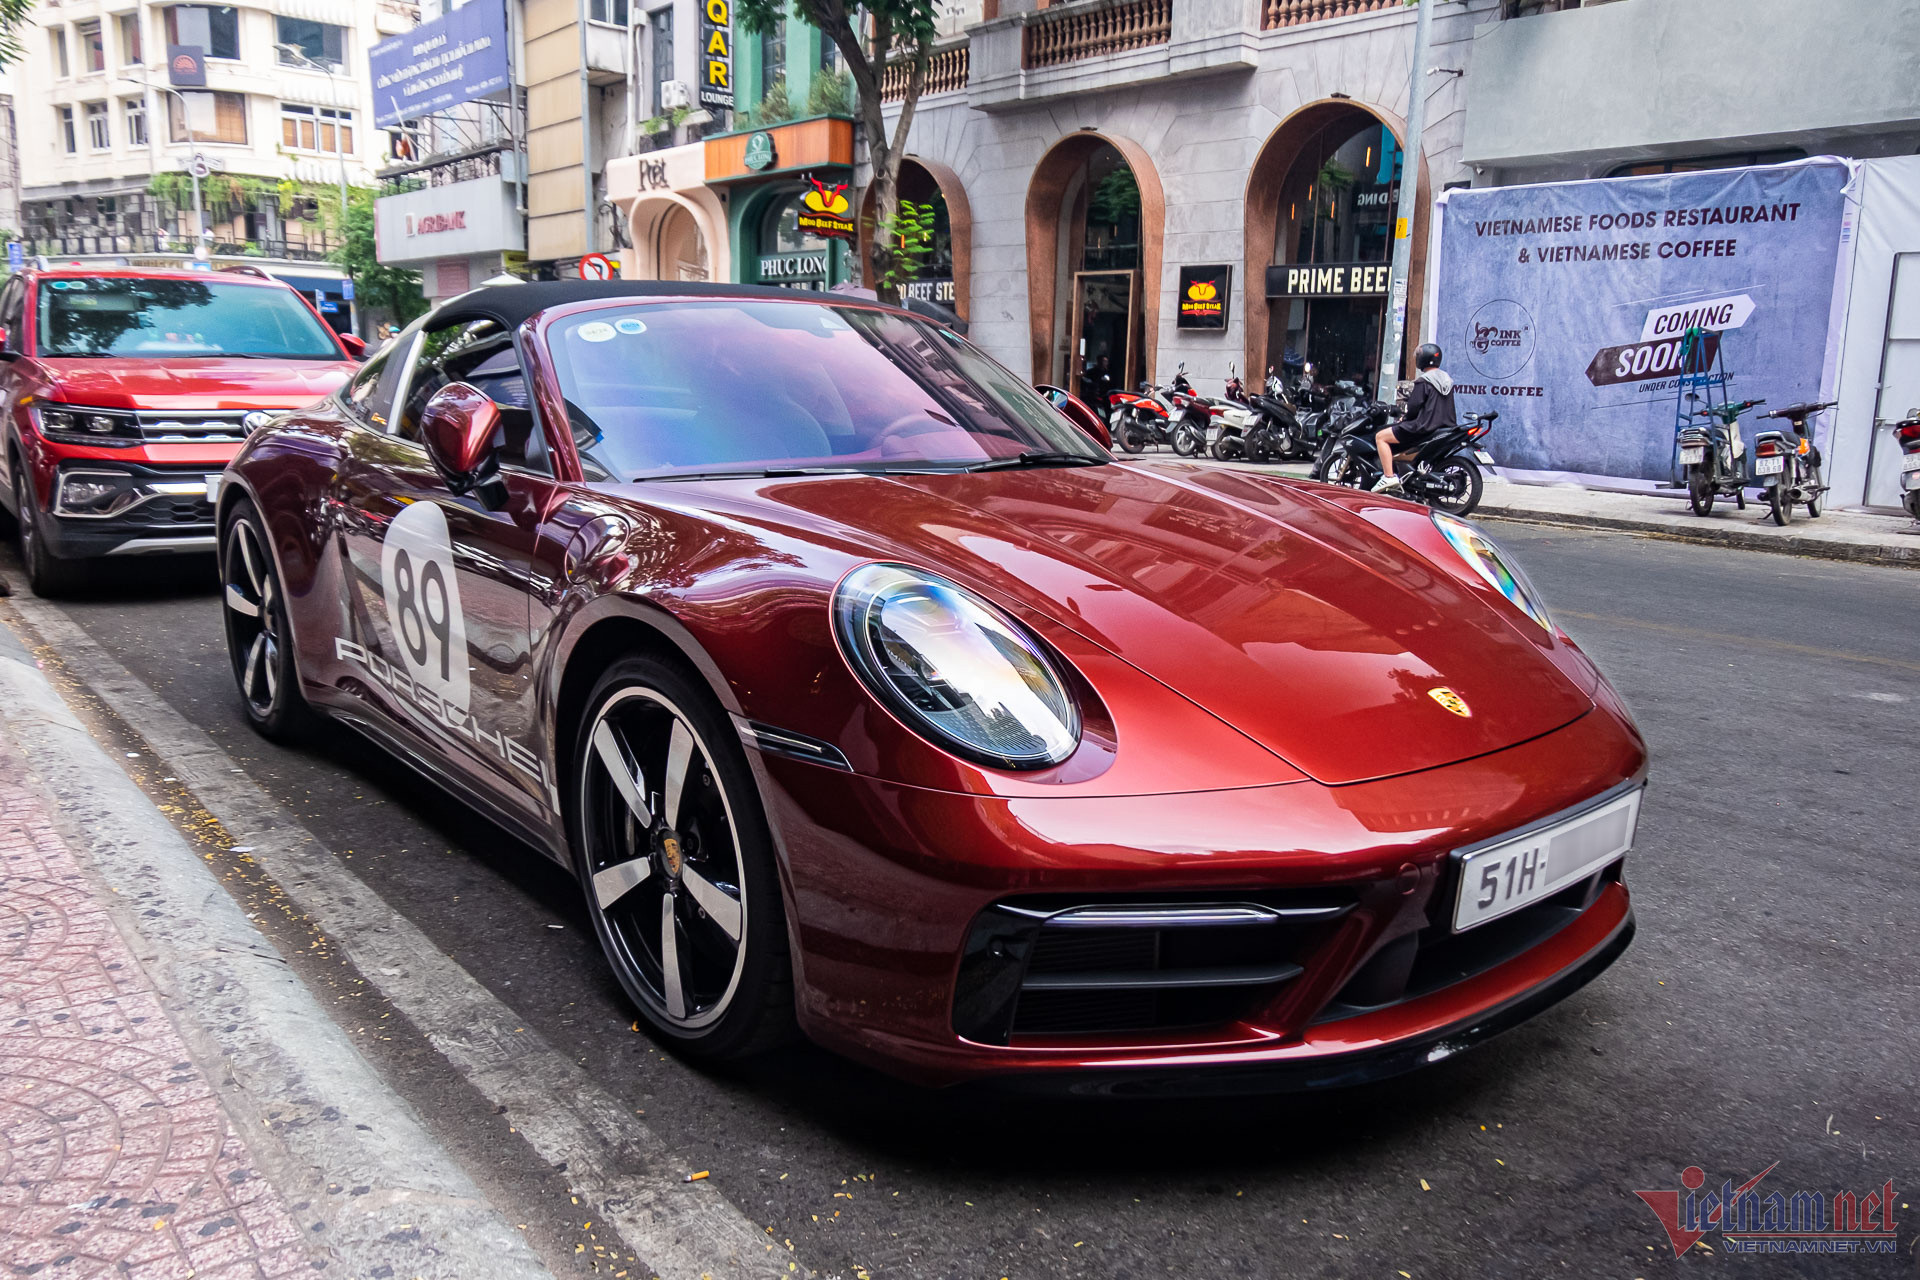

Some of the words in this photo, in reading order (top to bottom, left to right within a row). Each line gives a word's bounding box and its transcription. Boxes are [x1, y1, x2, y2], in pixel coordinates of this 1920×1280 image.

[701, 91, 734, 106] LOUNGE
[1475, 215, 1582, 237] VIETNAMESE
[1589, 211, 1656, 231] FOODS
[1663, 203, 1800, 228] RESTAURANT
[1518, 248, 1530, 263] &
[1537, 243, 1650, 263] VIETNAMESE
[1657, 239, 1737, 259] COFFEE
[761, 259, 794, 276] PHUC
[1287, 268, 1345, 294] PRIME
[1654, 304, 1733, 335] COMING
[1491, 386, 1544, 397] COFFEE
[1639, 381, 1666, 392] UNDER
[394, 548, 450, 682] 89
